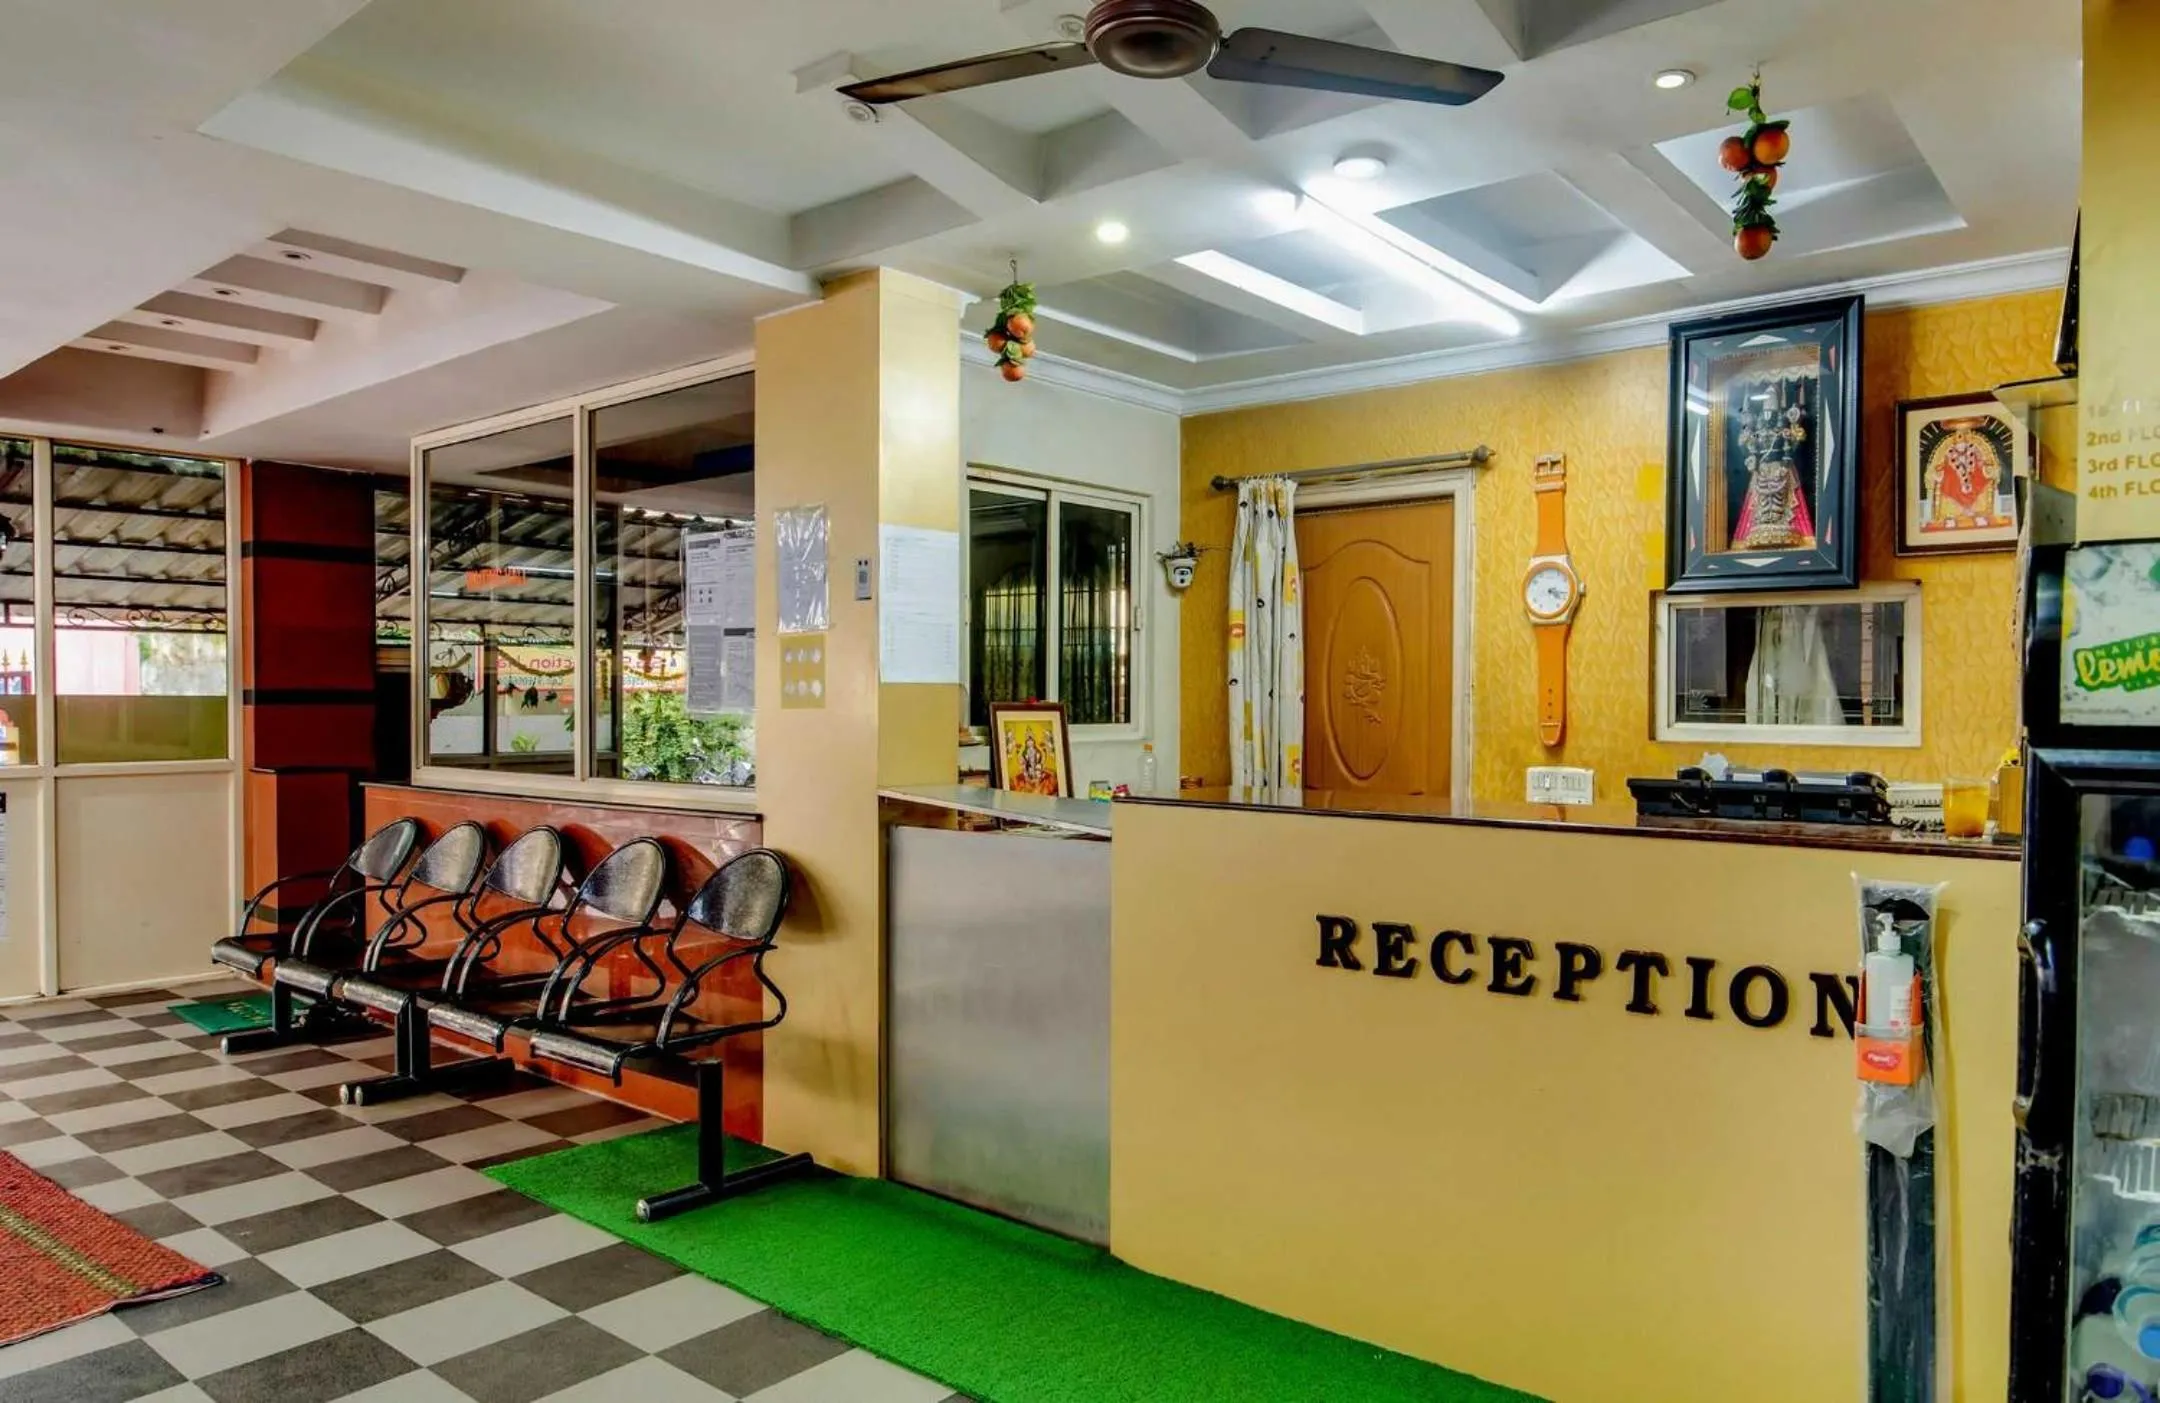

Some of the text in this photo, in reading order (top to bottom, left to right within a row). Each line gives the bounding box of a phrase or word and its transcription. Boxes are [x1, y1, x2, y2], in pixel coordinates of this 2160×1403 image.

[2086, 430, 2121, 447] 2nd
[2087, 457, 2118, 474] 3rd
[2087, 483, 2118, 500] 4th
[1315, 914, 1860, 1040] RECEPTION
